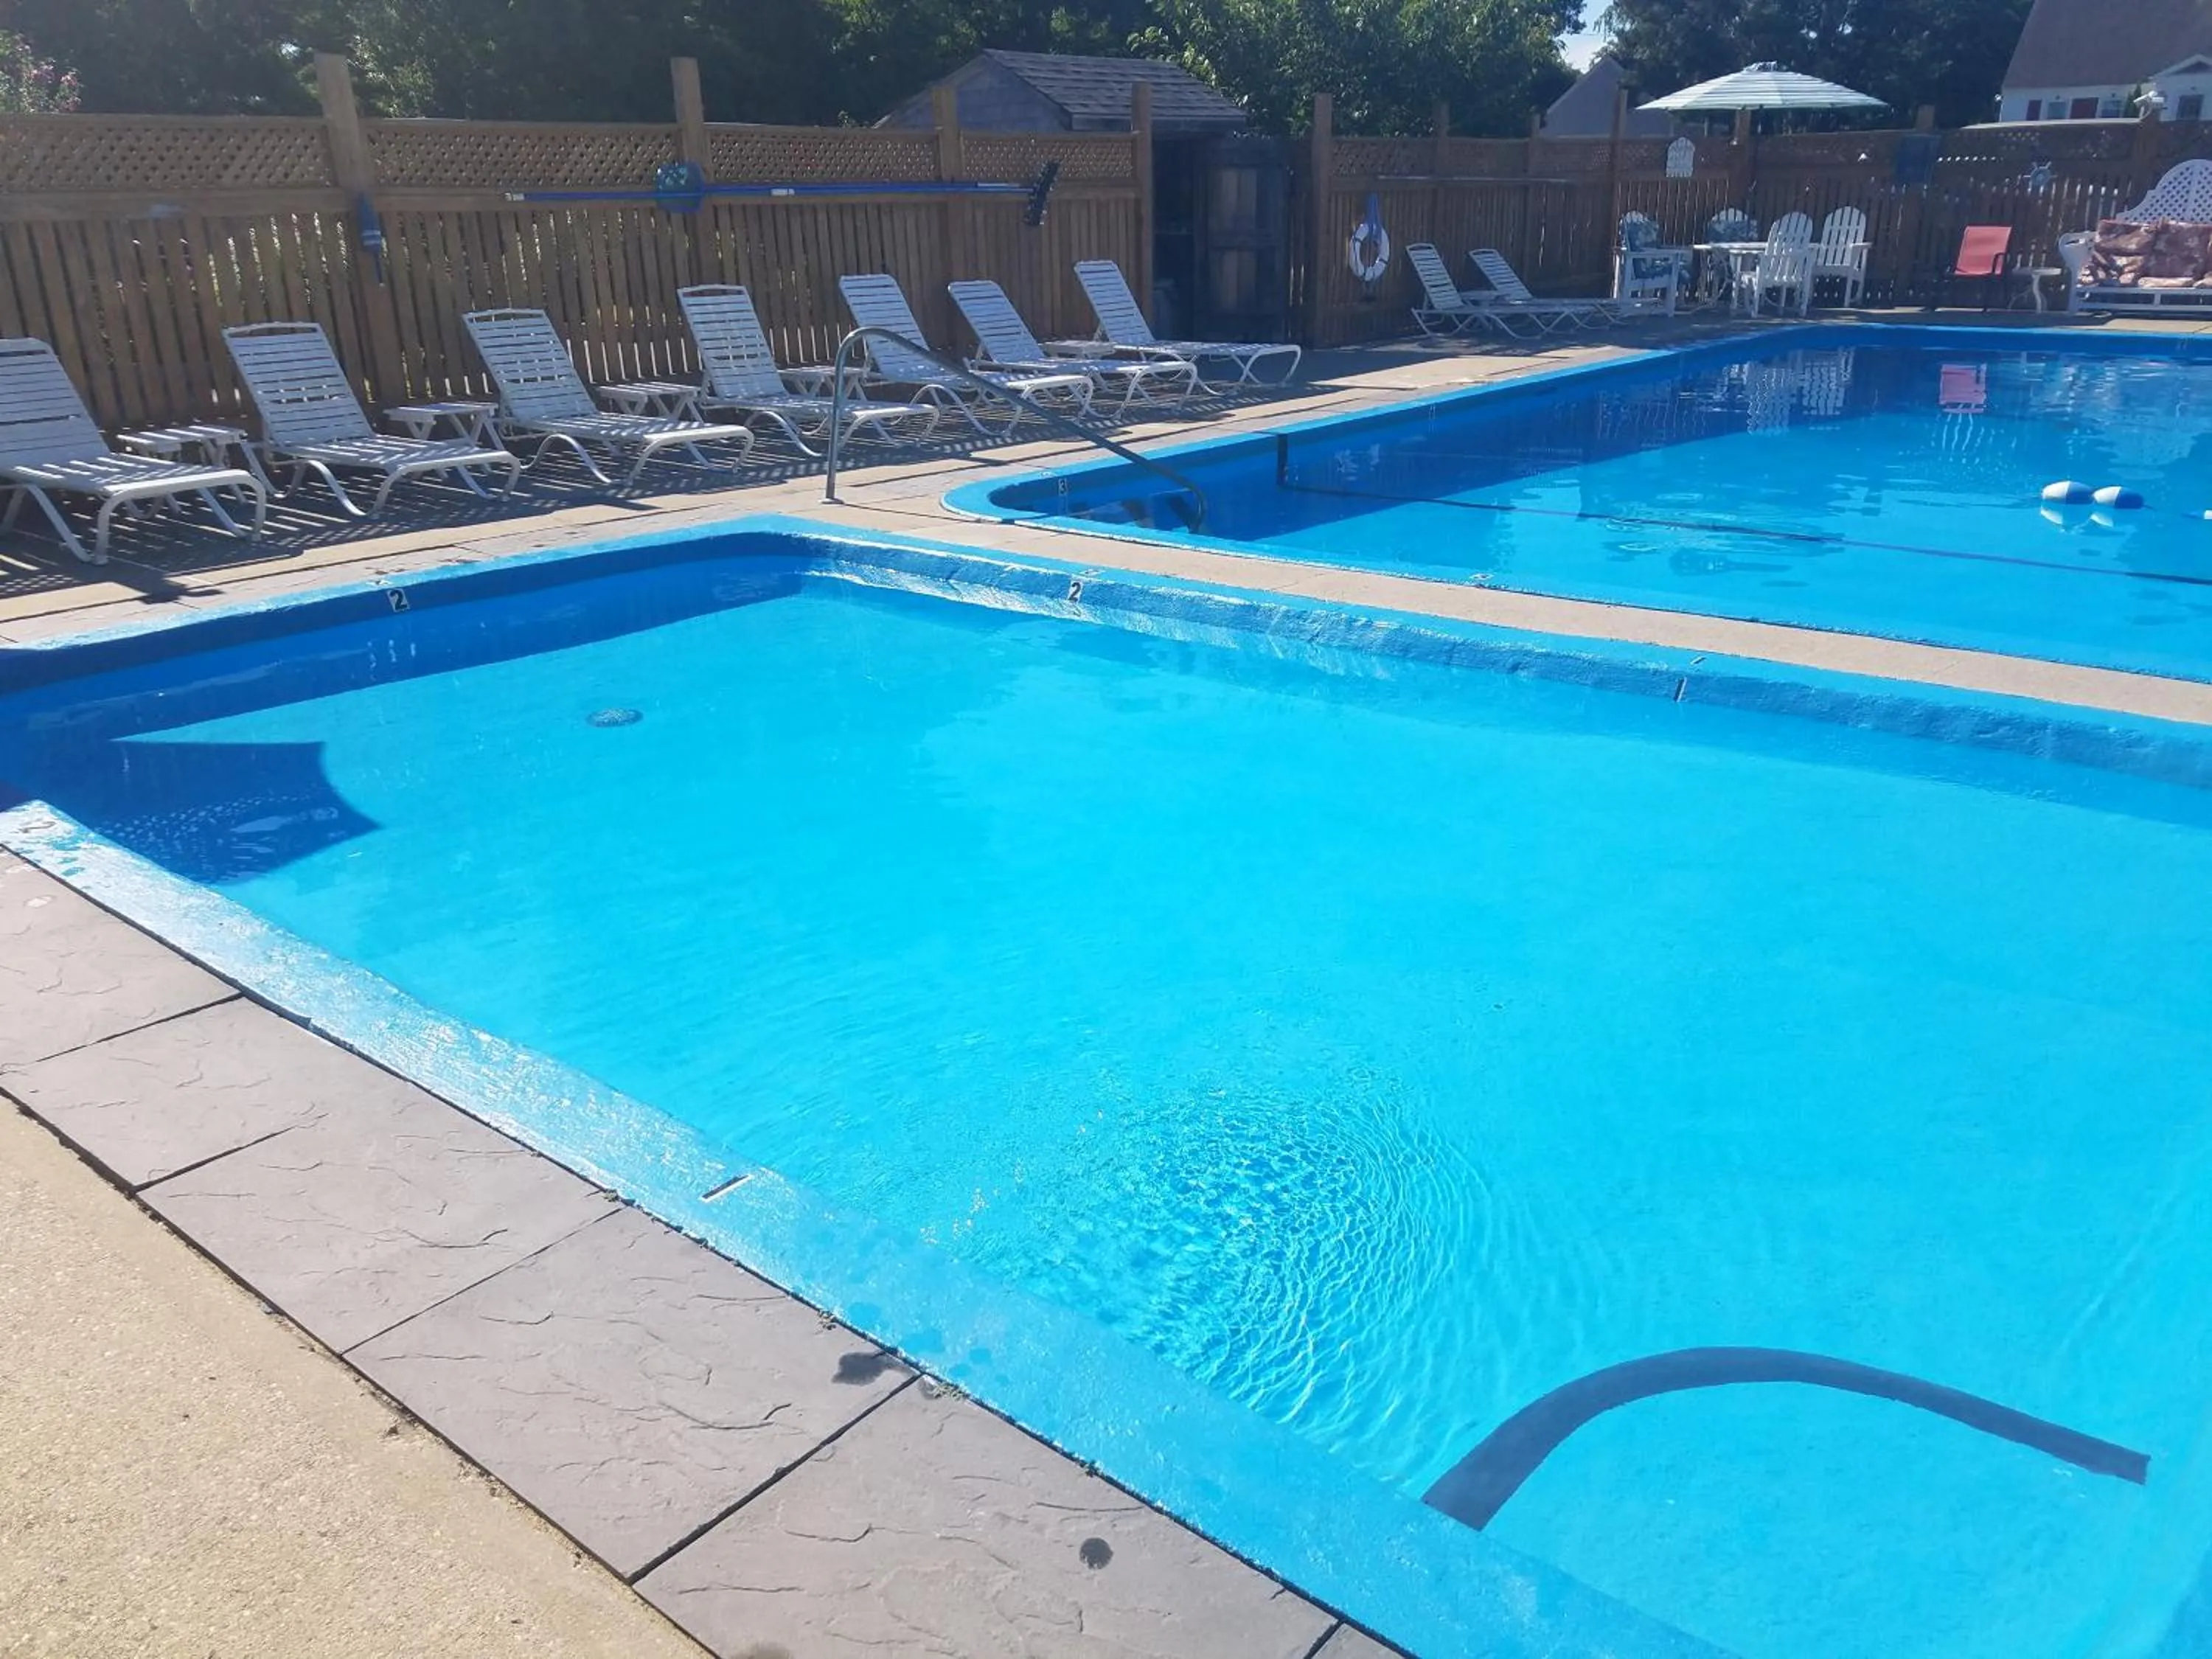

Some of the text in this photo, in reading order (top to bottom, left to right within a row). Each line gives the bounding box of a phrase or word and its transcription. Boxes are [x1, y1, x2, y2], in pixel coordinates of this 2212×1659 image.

[1060, 479, 1067, 494] 3
[389, 589, 408, 611] 2
[1068, 582, 1081, 602] 2
